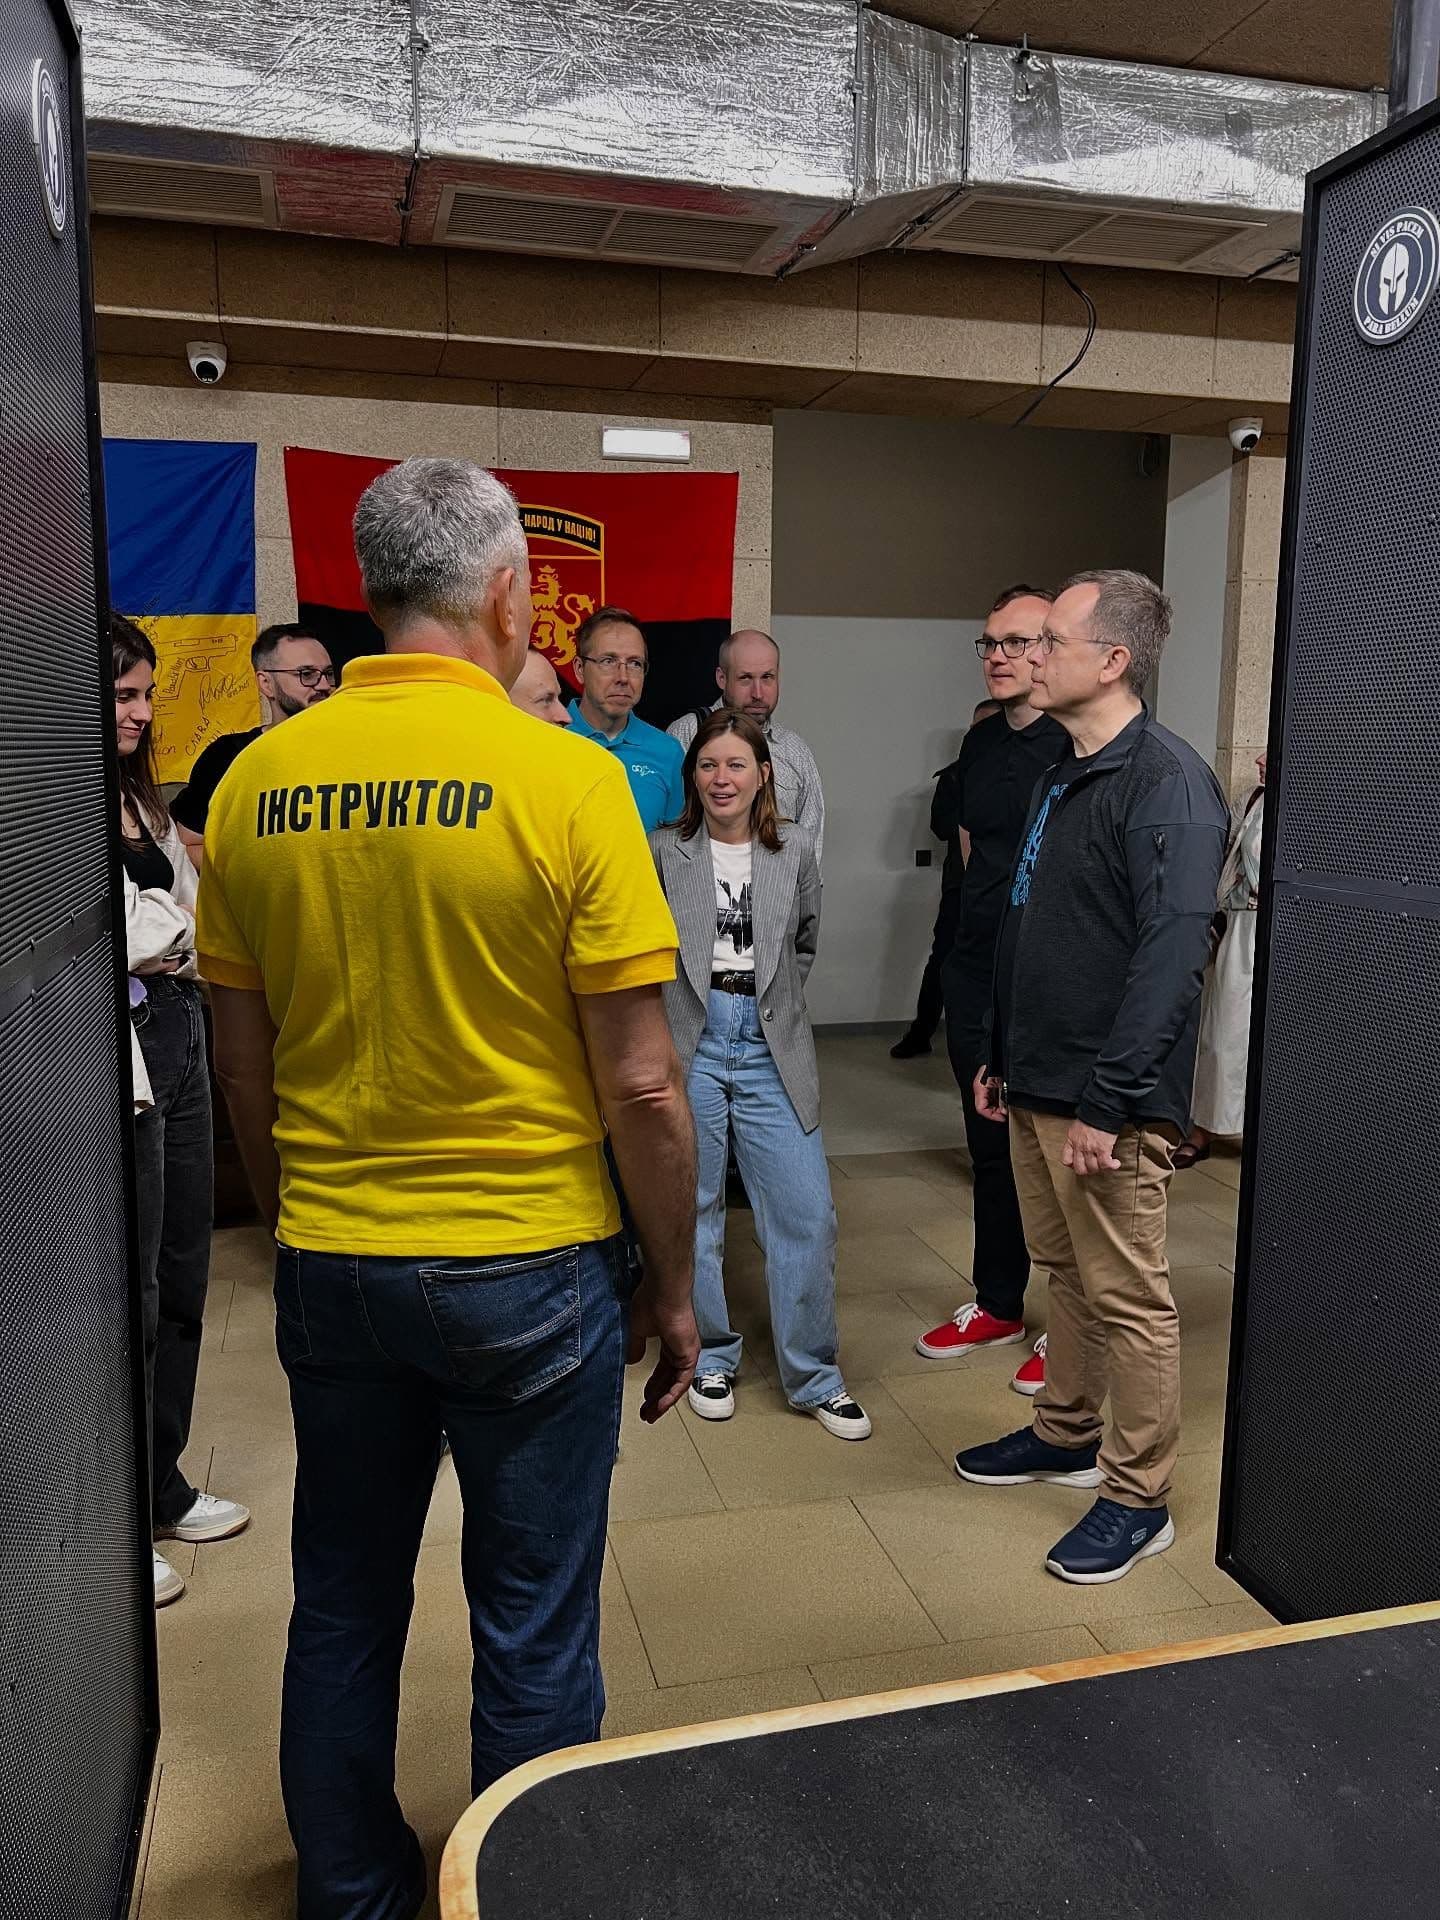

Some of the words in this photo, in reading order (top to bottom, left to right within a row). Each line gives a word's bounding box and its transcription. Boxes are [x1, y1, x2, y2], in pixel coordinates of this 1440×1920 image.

[1364, 315, 1384, 335] PARA
[1385, 297, 1419, 335] BELLUM
[556, 518, 562, 532] У
[564, 520, 596, 543] НАЦІЮ!
[257, 779, 494, 838] ІНСТРУКТОР
